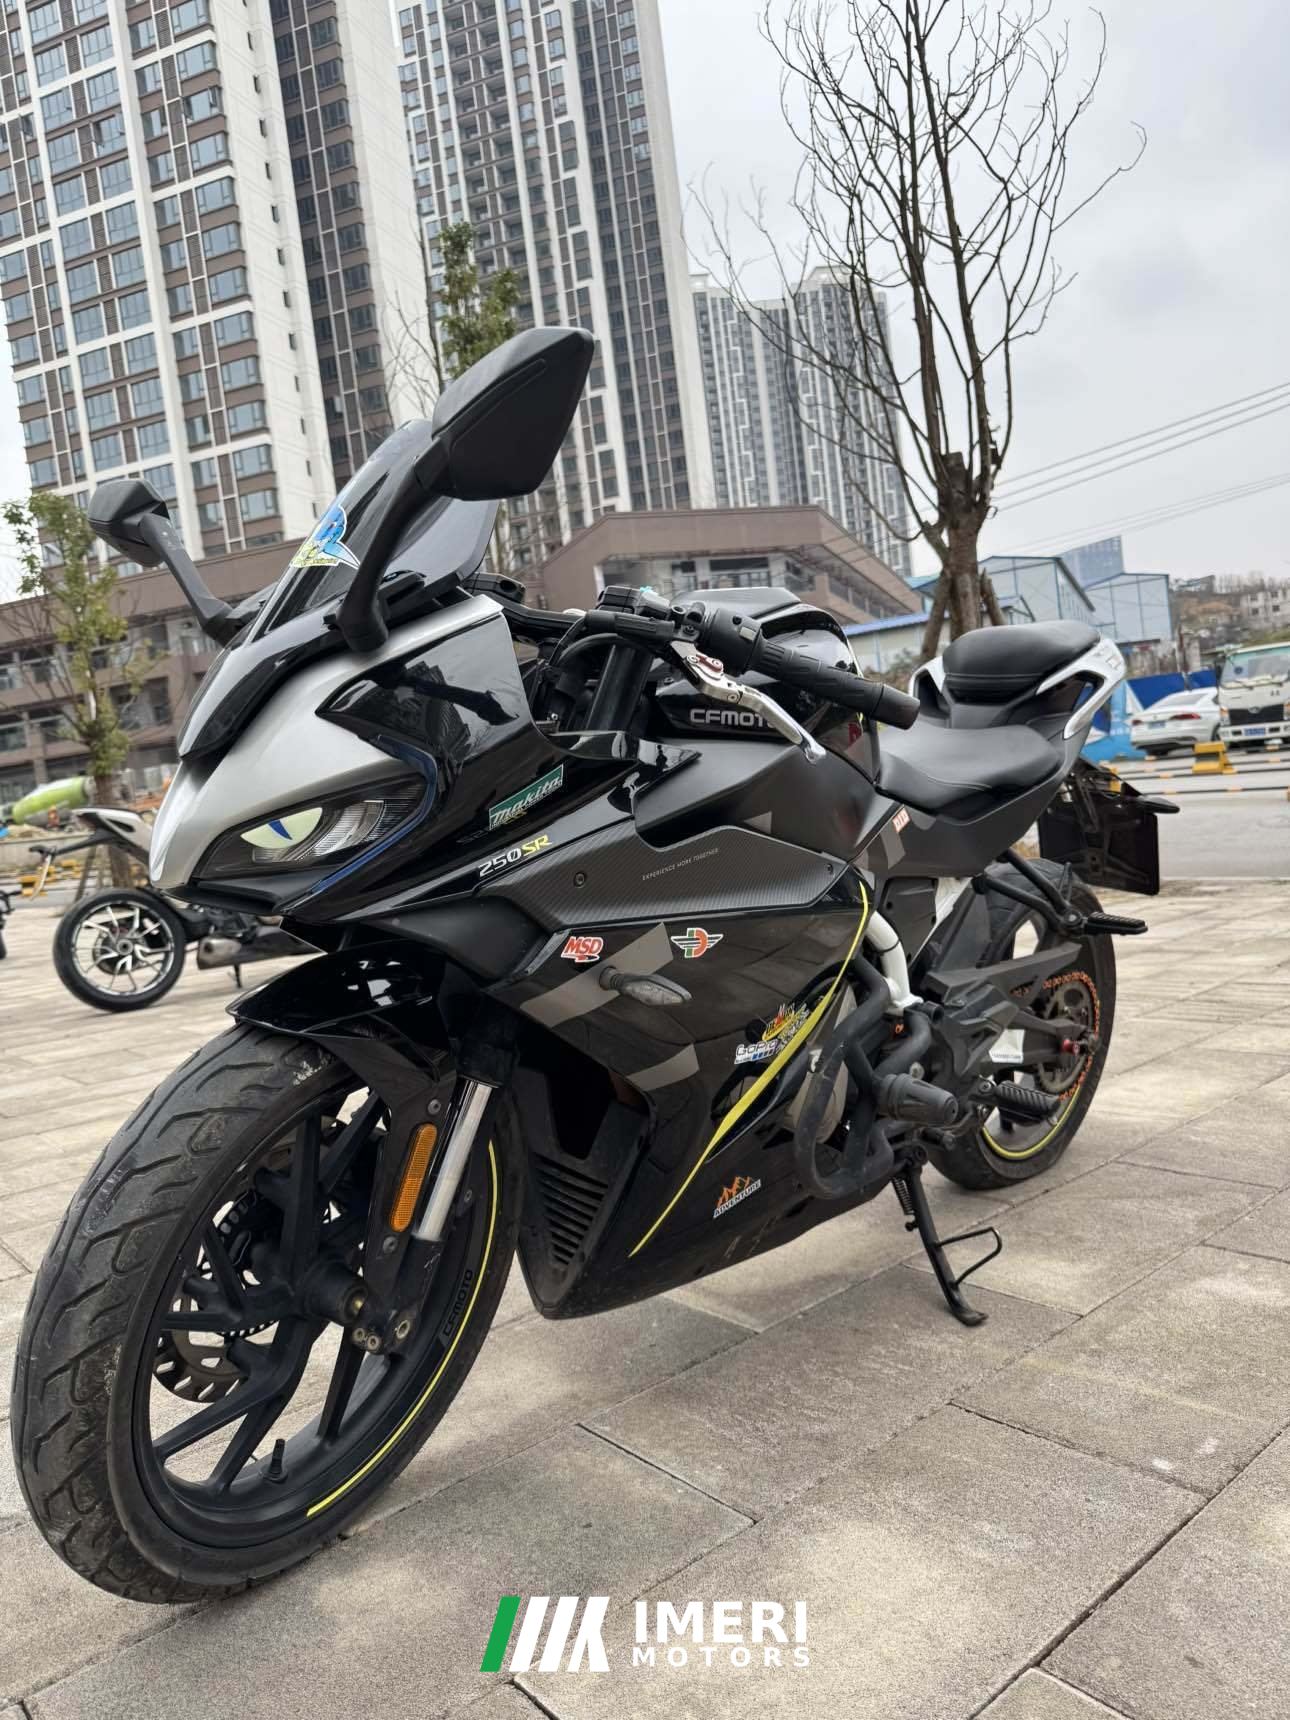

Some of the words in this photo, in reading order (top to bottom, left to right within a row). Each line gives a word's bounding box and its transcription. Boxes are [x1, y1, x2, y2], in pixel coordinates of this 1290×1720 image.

[689, 708, 776, 728] CFMOT
[642, 864, 675, 880] EXPERIENCE
[677, 858, 692, 868] MORE
[693, 848, 718, 860] TOGETHER
[563, 937, 603, 954] MSD
[713, 1179, 761, 1218] ADVENTURE
[443, 1269, 473, 1337] CFMOTO
